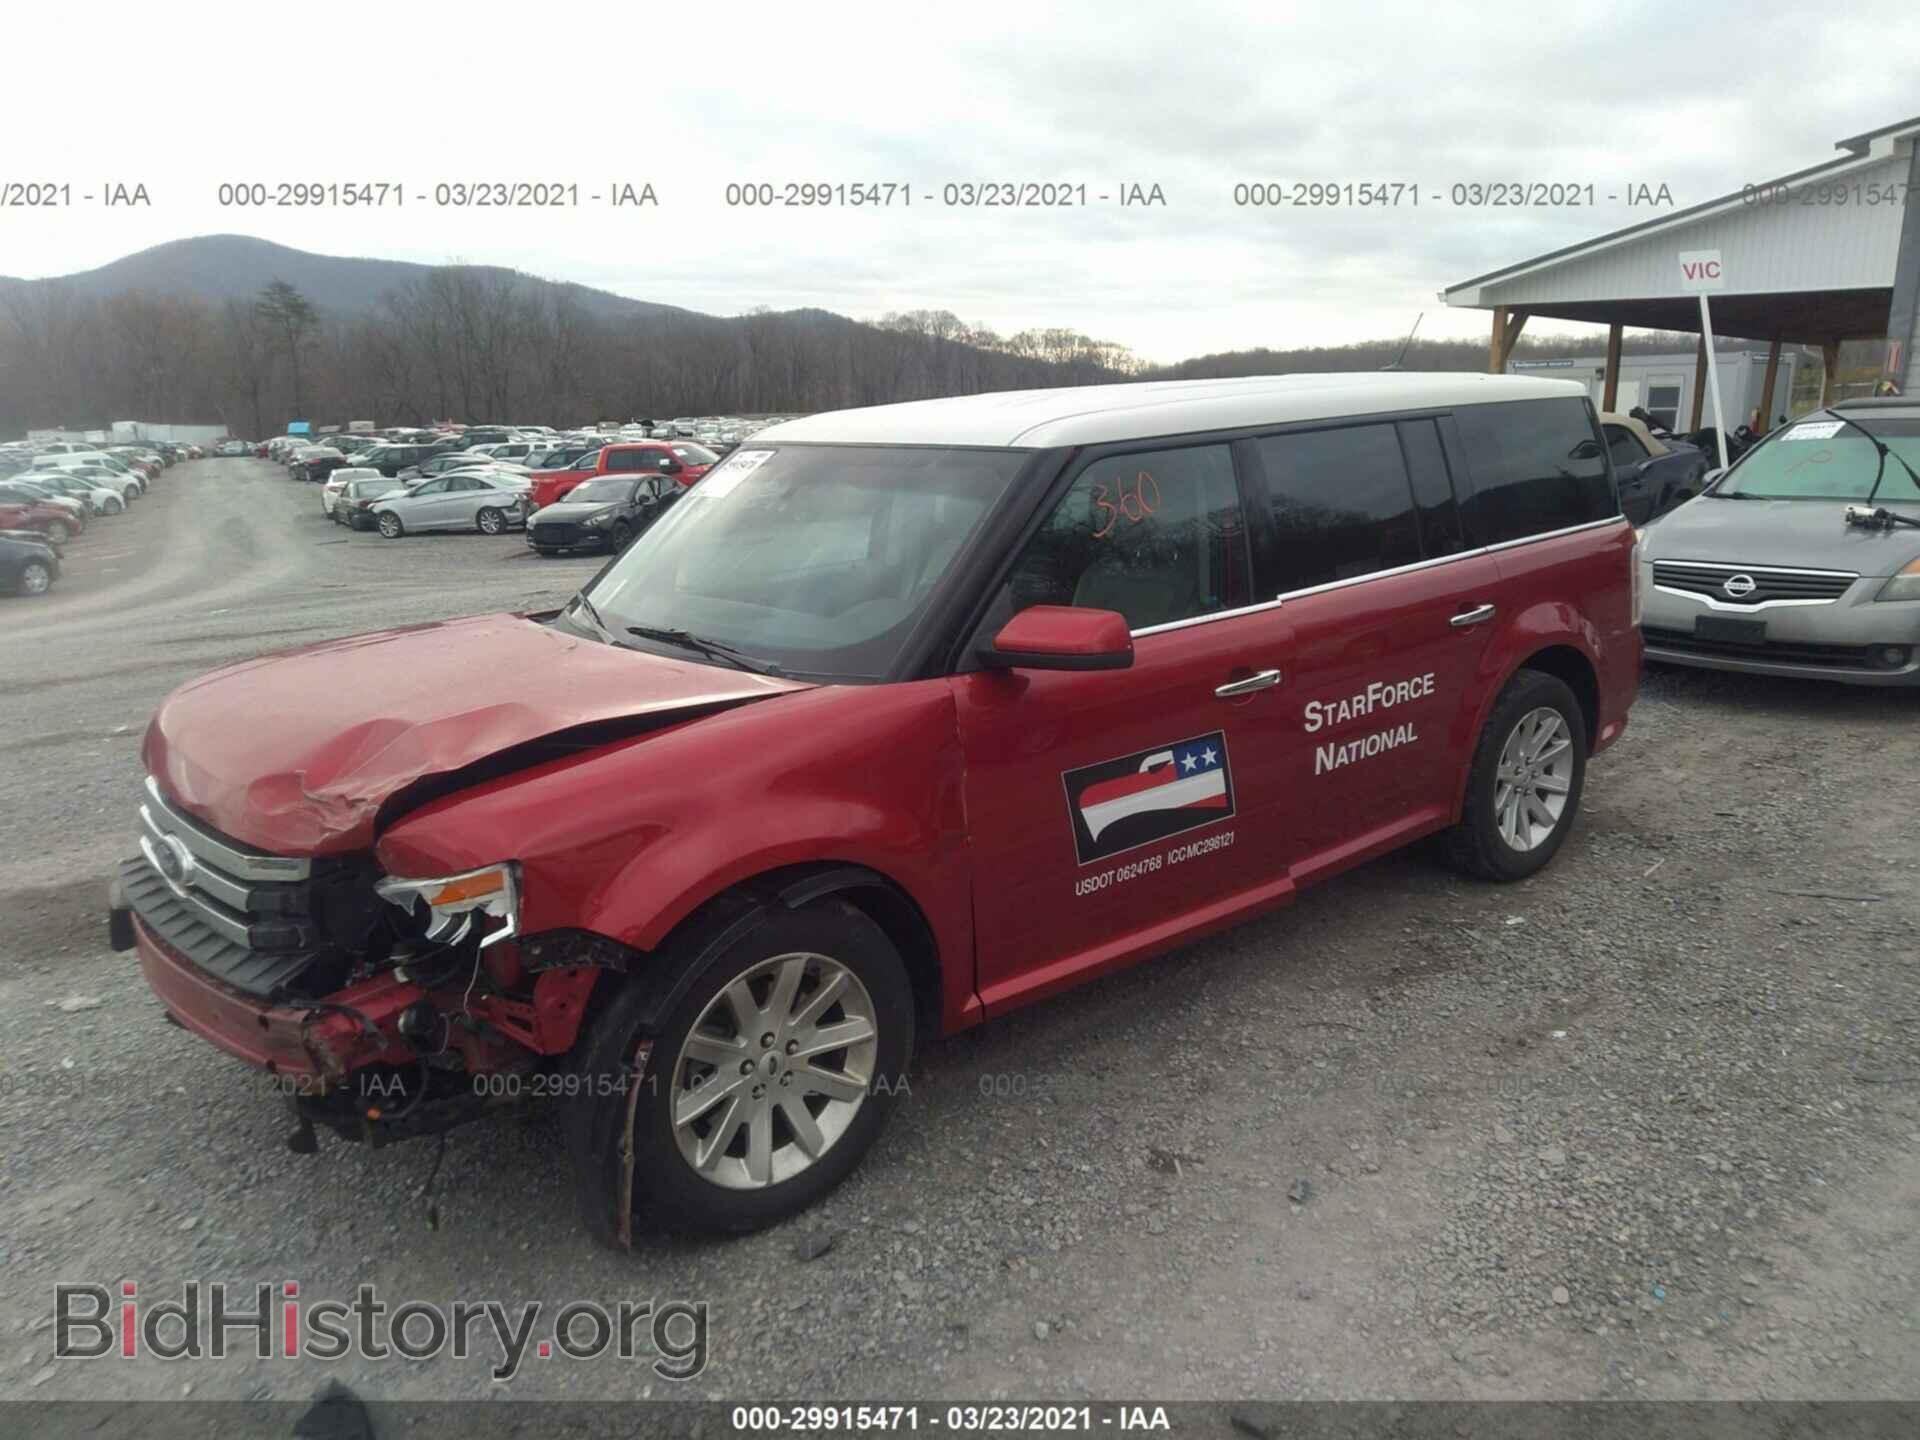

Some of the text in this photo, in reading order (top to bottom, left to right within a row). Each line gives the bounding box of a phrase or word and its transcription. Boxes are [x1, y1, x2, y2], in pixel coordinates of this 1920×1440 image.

[1683, 261, 1721, 280] VIC
[1092, 471, 1161, 538] 360
[1075, 870, 1116, 897] USDOT
[1116, 855, 1162, 883] 0624768
